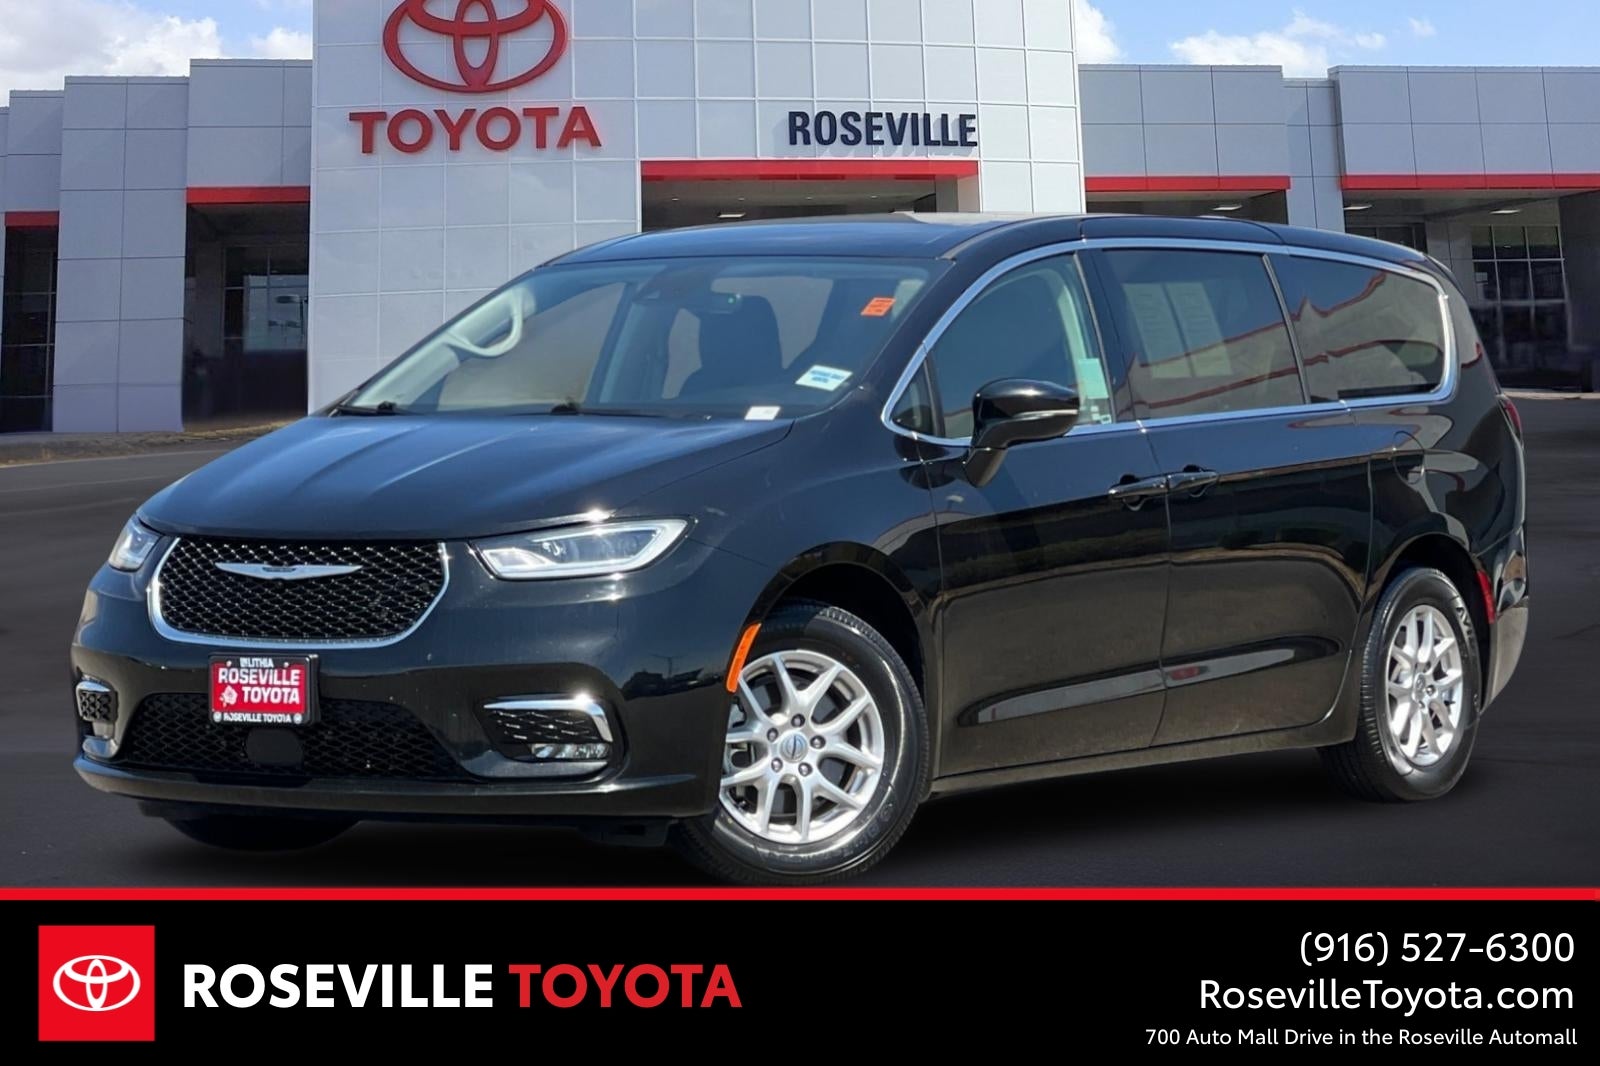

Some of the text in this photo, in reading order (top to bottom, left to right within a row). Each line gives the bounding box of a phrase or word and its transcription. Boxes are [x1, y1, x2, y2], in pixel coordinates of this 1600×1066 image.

[349, 106, 602, 154] TOYOTA
[788, 110, 978, 147] ROSEVILLE
[218, 668, 301, 686] ROSEVILLE
[242, 686, 300, 704] TOYOTA
[223, 712, 292, 723] ROSEVILLE TOYOTA
